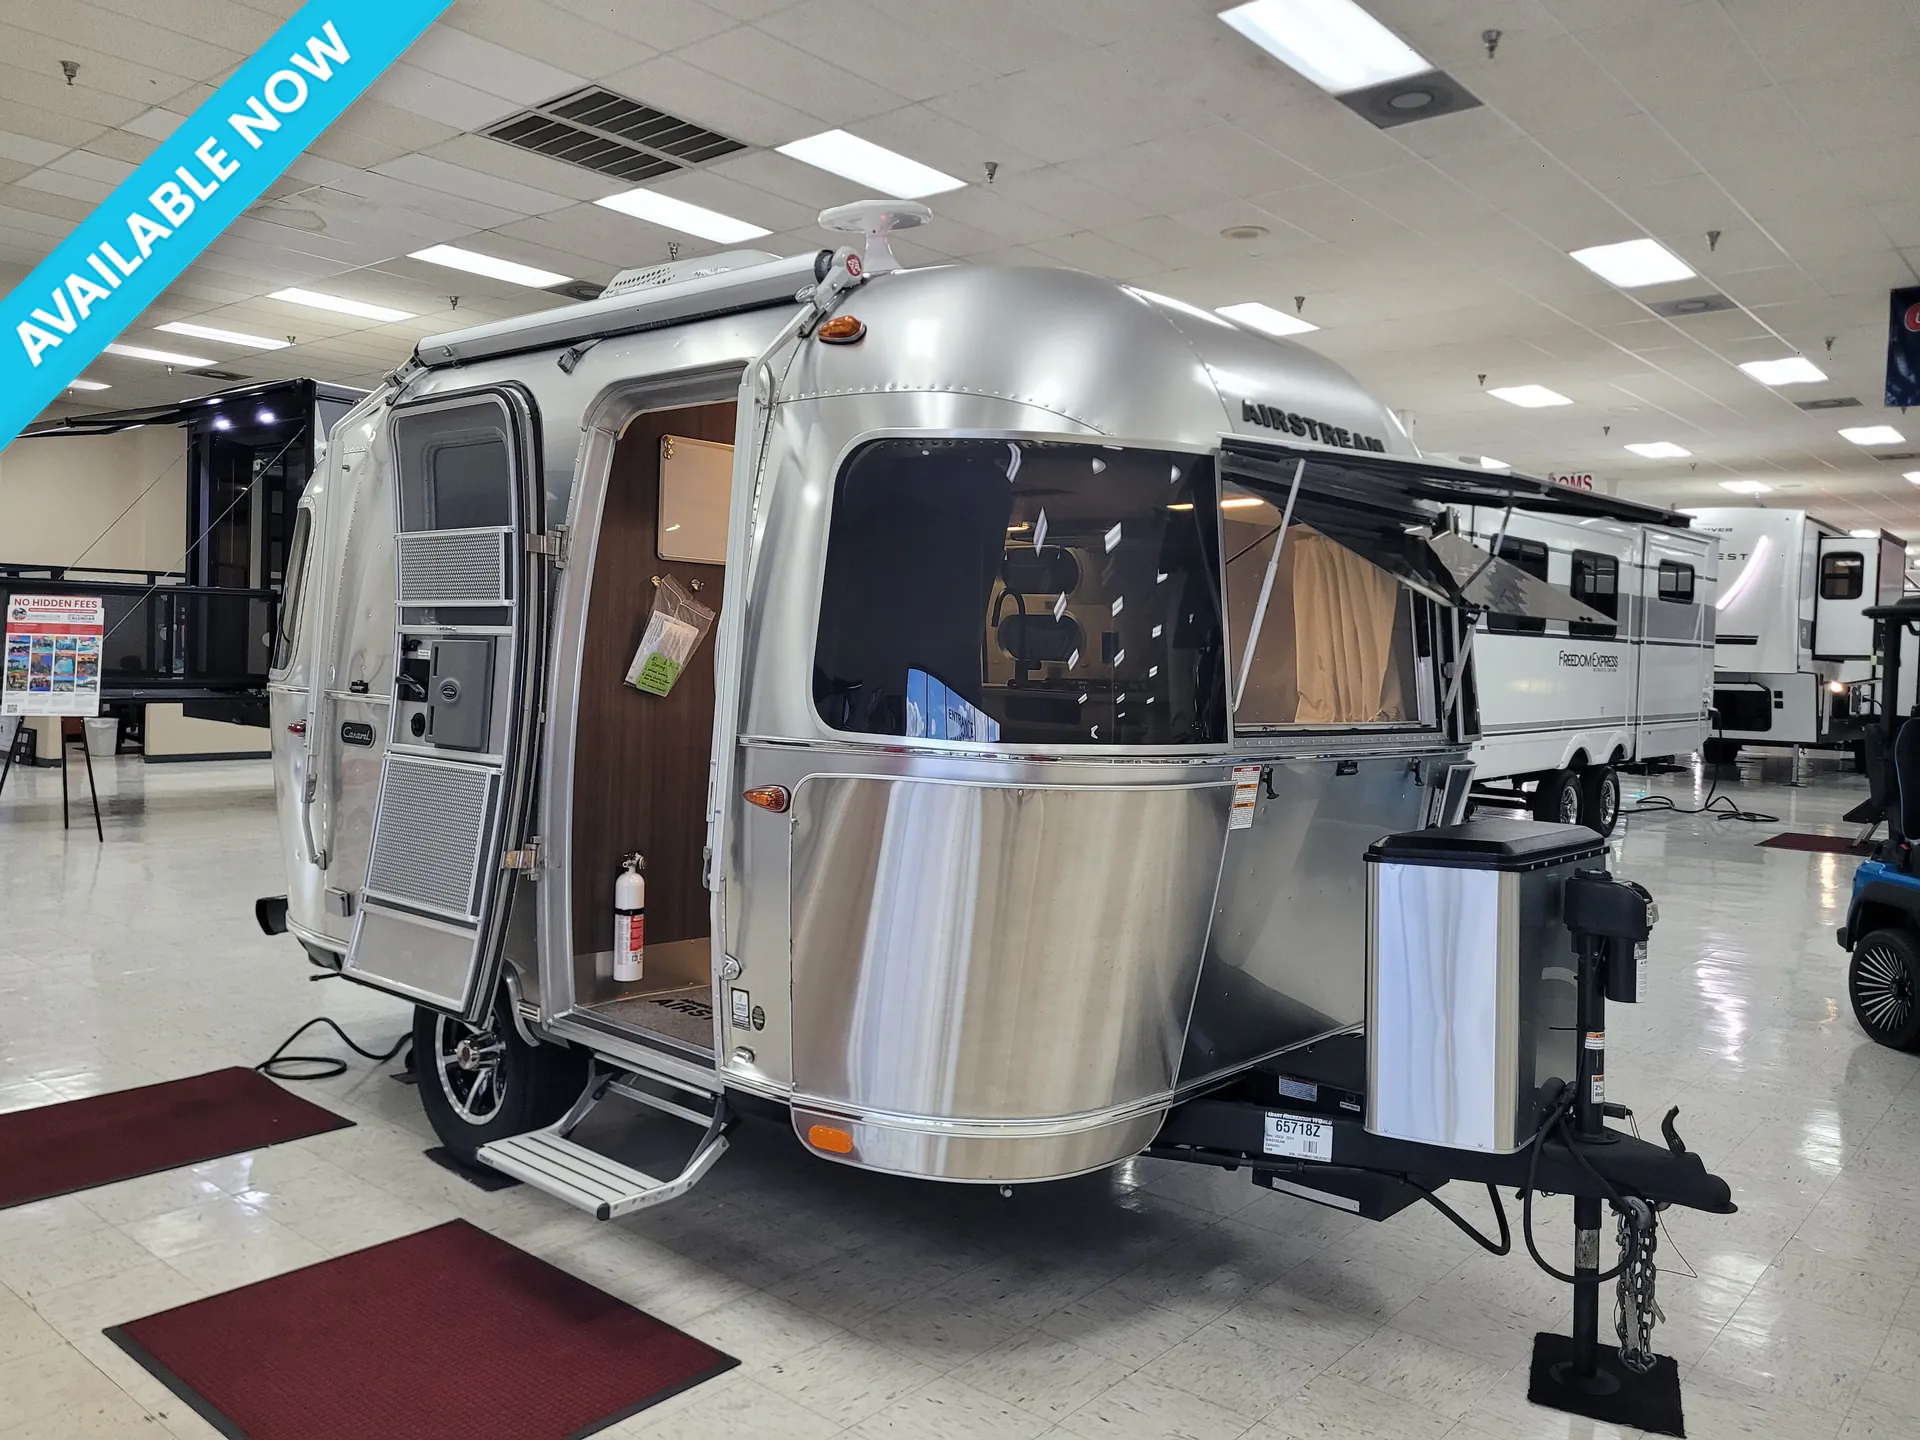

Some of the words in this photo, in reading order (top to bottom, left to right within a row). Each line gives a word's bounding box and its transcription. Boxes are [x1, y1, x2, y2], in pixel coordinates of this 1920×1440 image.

[1242, 398, 1385, 453] AIRSTREAM
[14, 598, 30, 606] NO
[32, 599, 72, 608] HIDDEN
[74, 600, 98, 608] FEES
[1276, 1120, 1320, 1137] 65718Z
